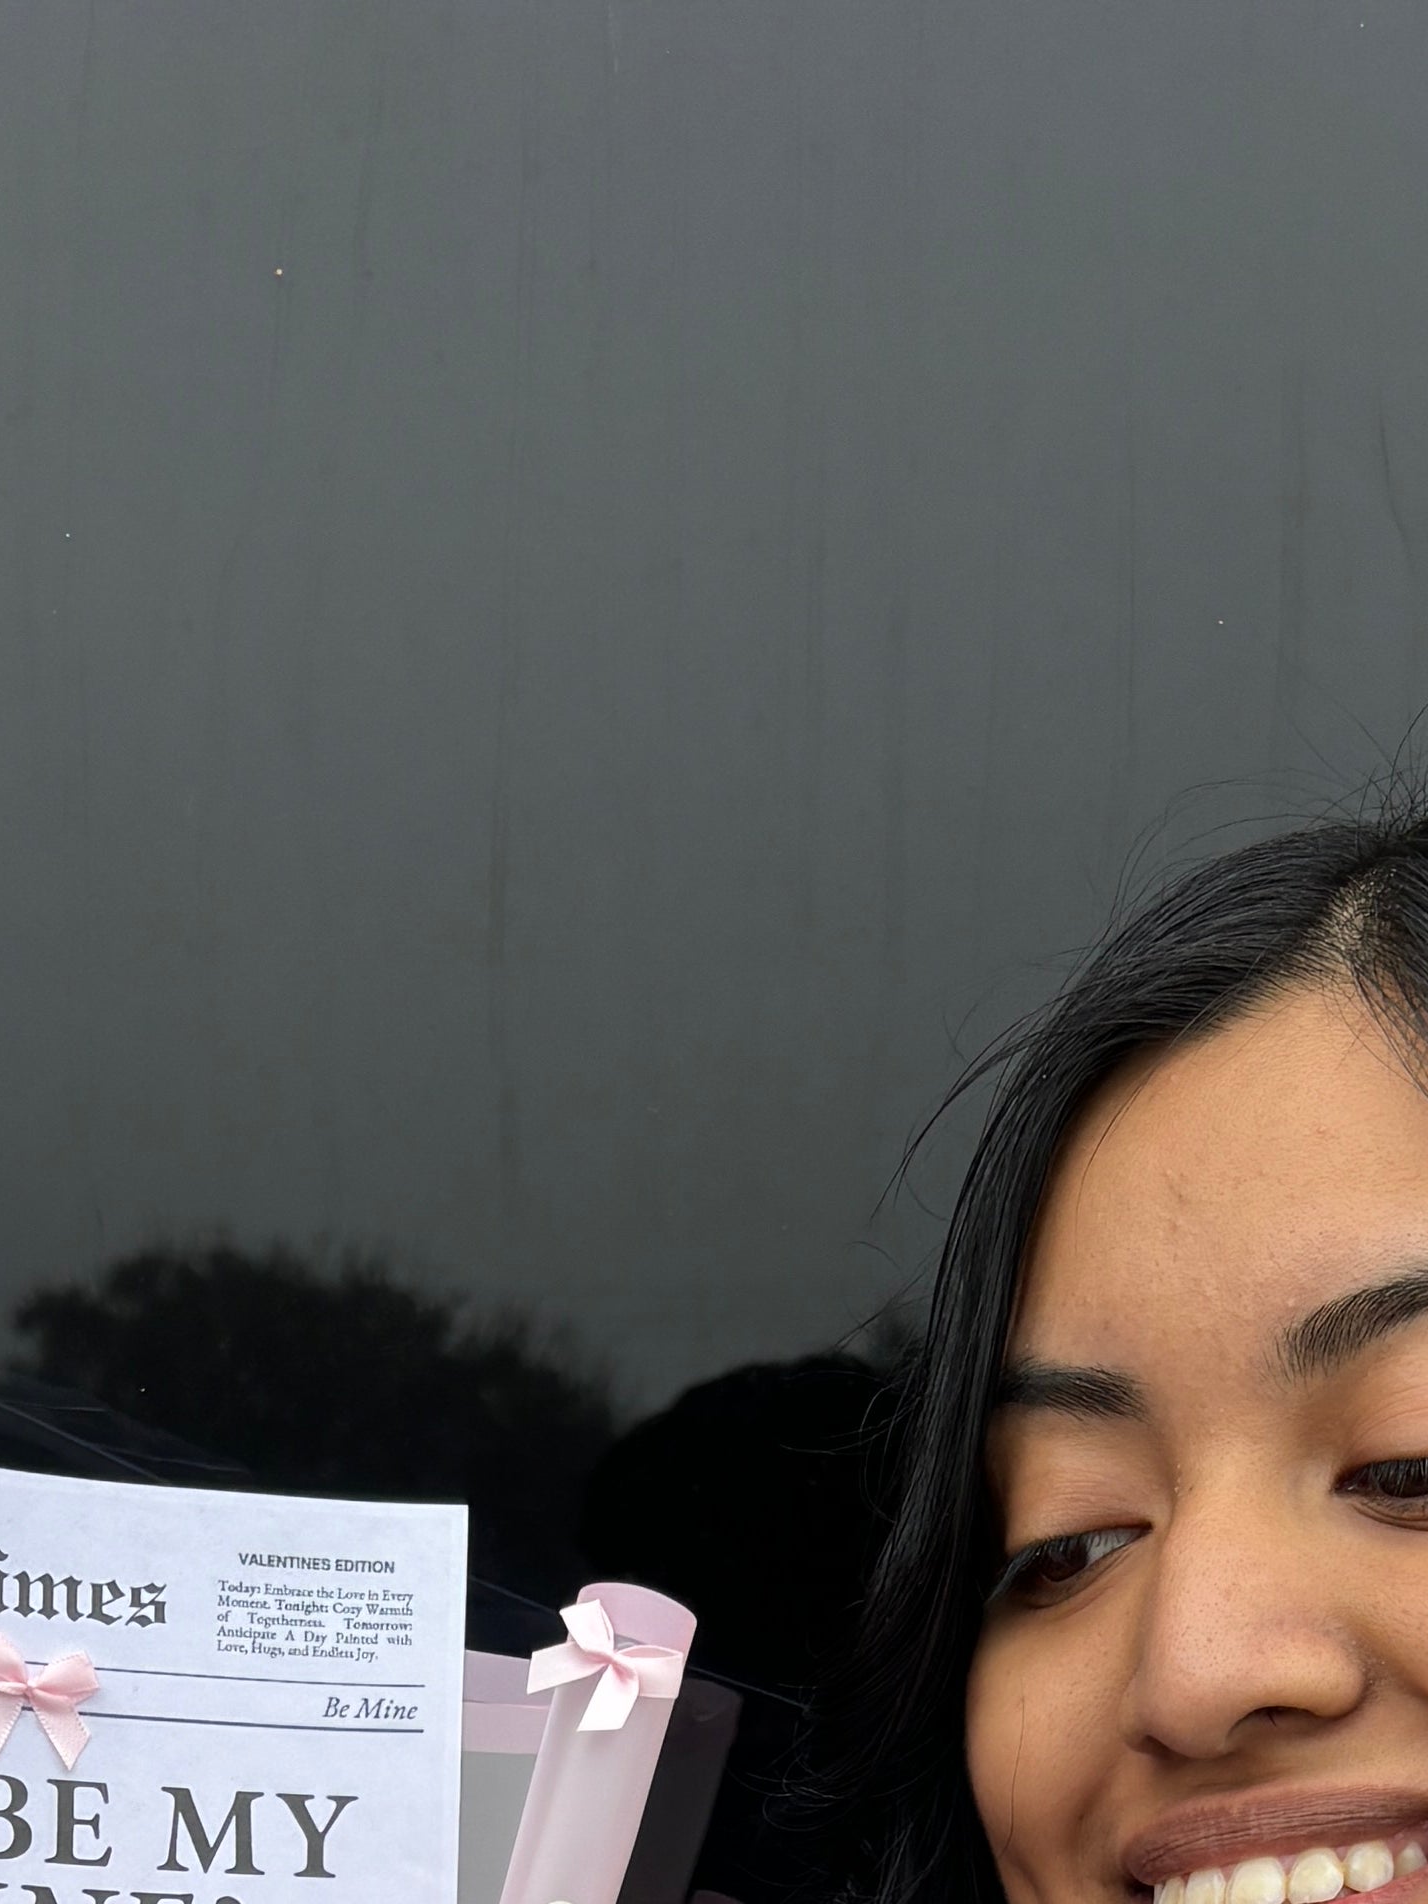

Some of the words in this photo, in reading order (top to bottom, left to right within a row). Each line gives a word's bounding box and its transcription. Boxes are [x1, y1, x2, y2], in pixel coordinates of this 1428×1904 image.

[239, 1553, 331, 1571] VALENTINES
[335, 1559, 395, 1573] EDITION
[218, 1580, 260, 1597] Today:
[265, 1583, 313, 1597] Embrace
[317, 1586, 334, 1599] the
[338, 1588, 365, 1600] Love
[382, 1590, 413, 1606] Every
[218, 1595, 270, 1610] Moment.
[275, 1599, 328, 1615] Tonight:
[333, 1603, 362, 1616] Cozy
[366, 1603, 413, 1616] Warmth
[217, 1611, 231, 1622] of
[247, 1612, 325, 1629] Togetherness.
[344, 1618, 412, 1631] Tomorrow:
[217, 1626, 276, 1645] Anticipate
[285, 1631, 294, 1641] A
[304, 1631, 327, 1647] Day
[336, 1632, 378, 1645] Painted
[387, 1633, 412, 1646] with
[217, 1640, 248, 1654] Love,
[252, 1643, 285, 1658] Hugs,
[288, 1644, 309, 1656] and
[312, 1645, 354, 1659] Endless
[356, 1647, 378, 1662] Joy.
[322, 1696, 350, 1718] Be
[353, 1697, 419, 1720] Mine
[157, 1786, 360, 1879] MY
